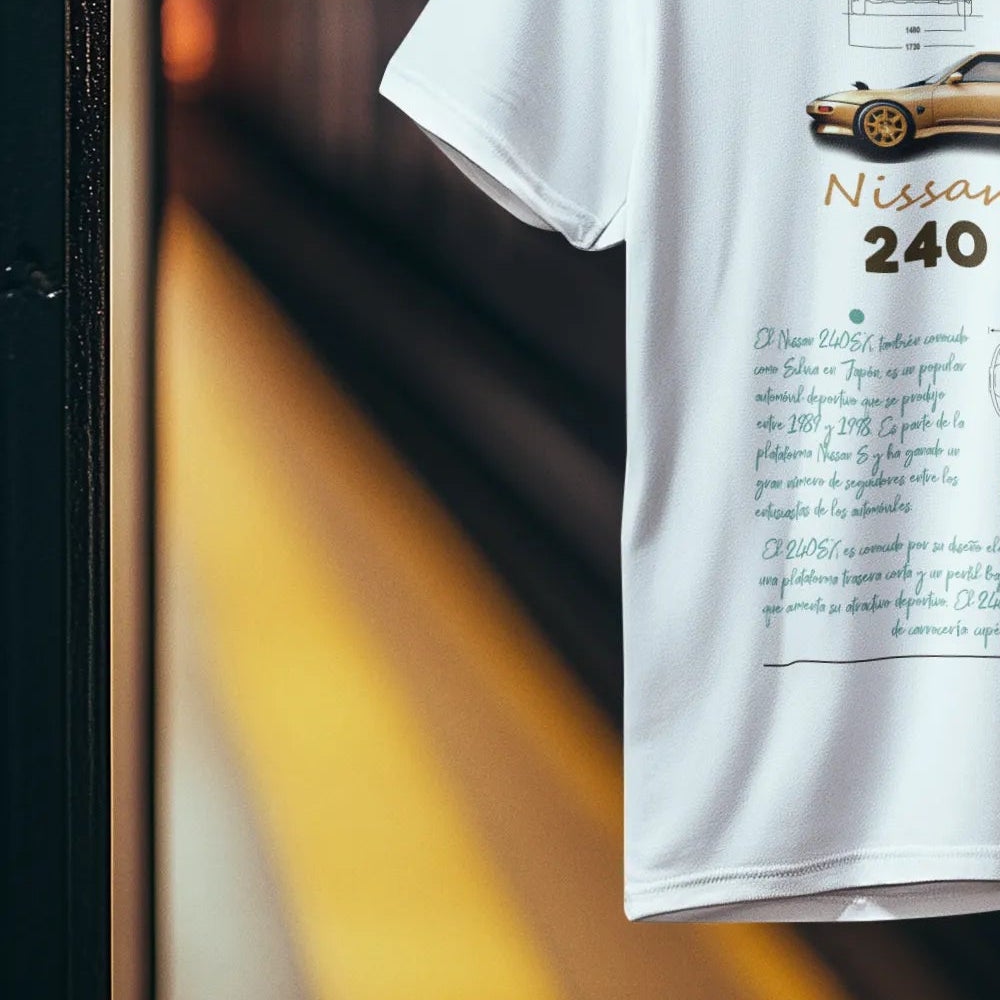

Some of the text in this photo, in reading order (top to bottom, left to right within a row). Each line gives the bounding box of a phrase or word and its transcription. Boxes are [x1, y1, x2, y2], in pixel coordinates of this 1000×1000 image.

[864, 220, 987, 273] 240
[753, 327, 775, 350] El
[778, 328, 814, 350] Nissan
[878, 332, 921, 353] también
[923, 325, 969, 346] conocido
[753, 366, 778, 376] como
[783, 356, 819, 379] Silvia
[823, 366, 836, 375] en
[885, 367, 899, 380] es
[902, 365, 915, 376] un
[918, 352, 967, 387] popular
[755, 383, 945, 420] automóvil deportivo que se produjo
[756, 413, 785, 433] entre
[786, 412, 822, 435] 1989
[824, 424, 835, 449] y
[878, 415, 897, 438] Es
[900, 413, 933, 444] parte
[936, 411, 951, 430] de
[953, 410, 965, 428] la
[755, 439, 961, 476] plataforma Nissan S y ha ganado un
[754, 465, 960, 501] gran número de seguidores entre los
[754, 500, 811, 520] entusiastas
[814, 498, 828, 518] de
[831, 498, 848, 519] los
[761, 538, 783, 560] El
[843, 547, 857, 559] es
[859, 532, 904, 555] conocido
[907, 540, 930, 563] por
[932, 541, 945, 553] su
[948, 534, 982, 554] diseño
[759, 575, 779, 587] una
[780, 567, 840, 600] plataforma
[842, 567, 883, 588] trasera
[884, 561, 913, 583] corta
[915, 569, 928, 596] y
[929, 569, 943, 580] un
[944, 562, 983, 592] perfil
[761, 603, 783, 628] que
[828, 603, 842, 615] su
[845, 593, 892, 616] atractivo
[953, 588, 976, 612] El
[891, 618, 906, 639] de
